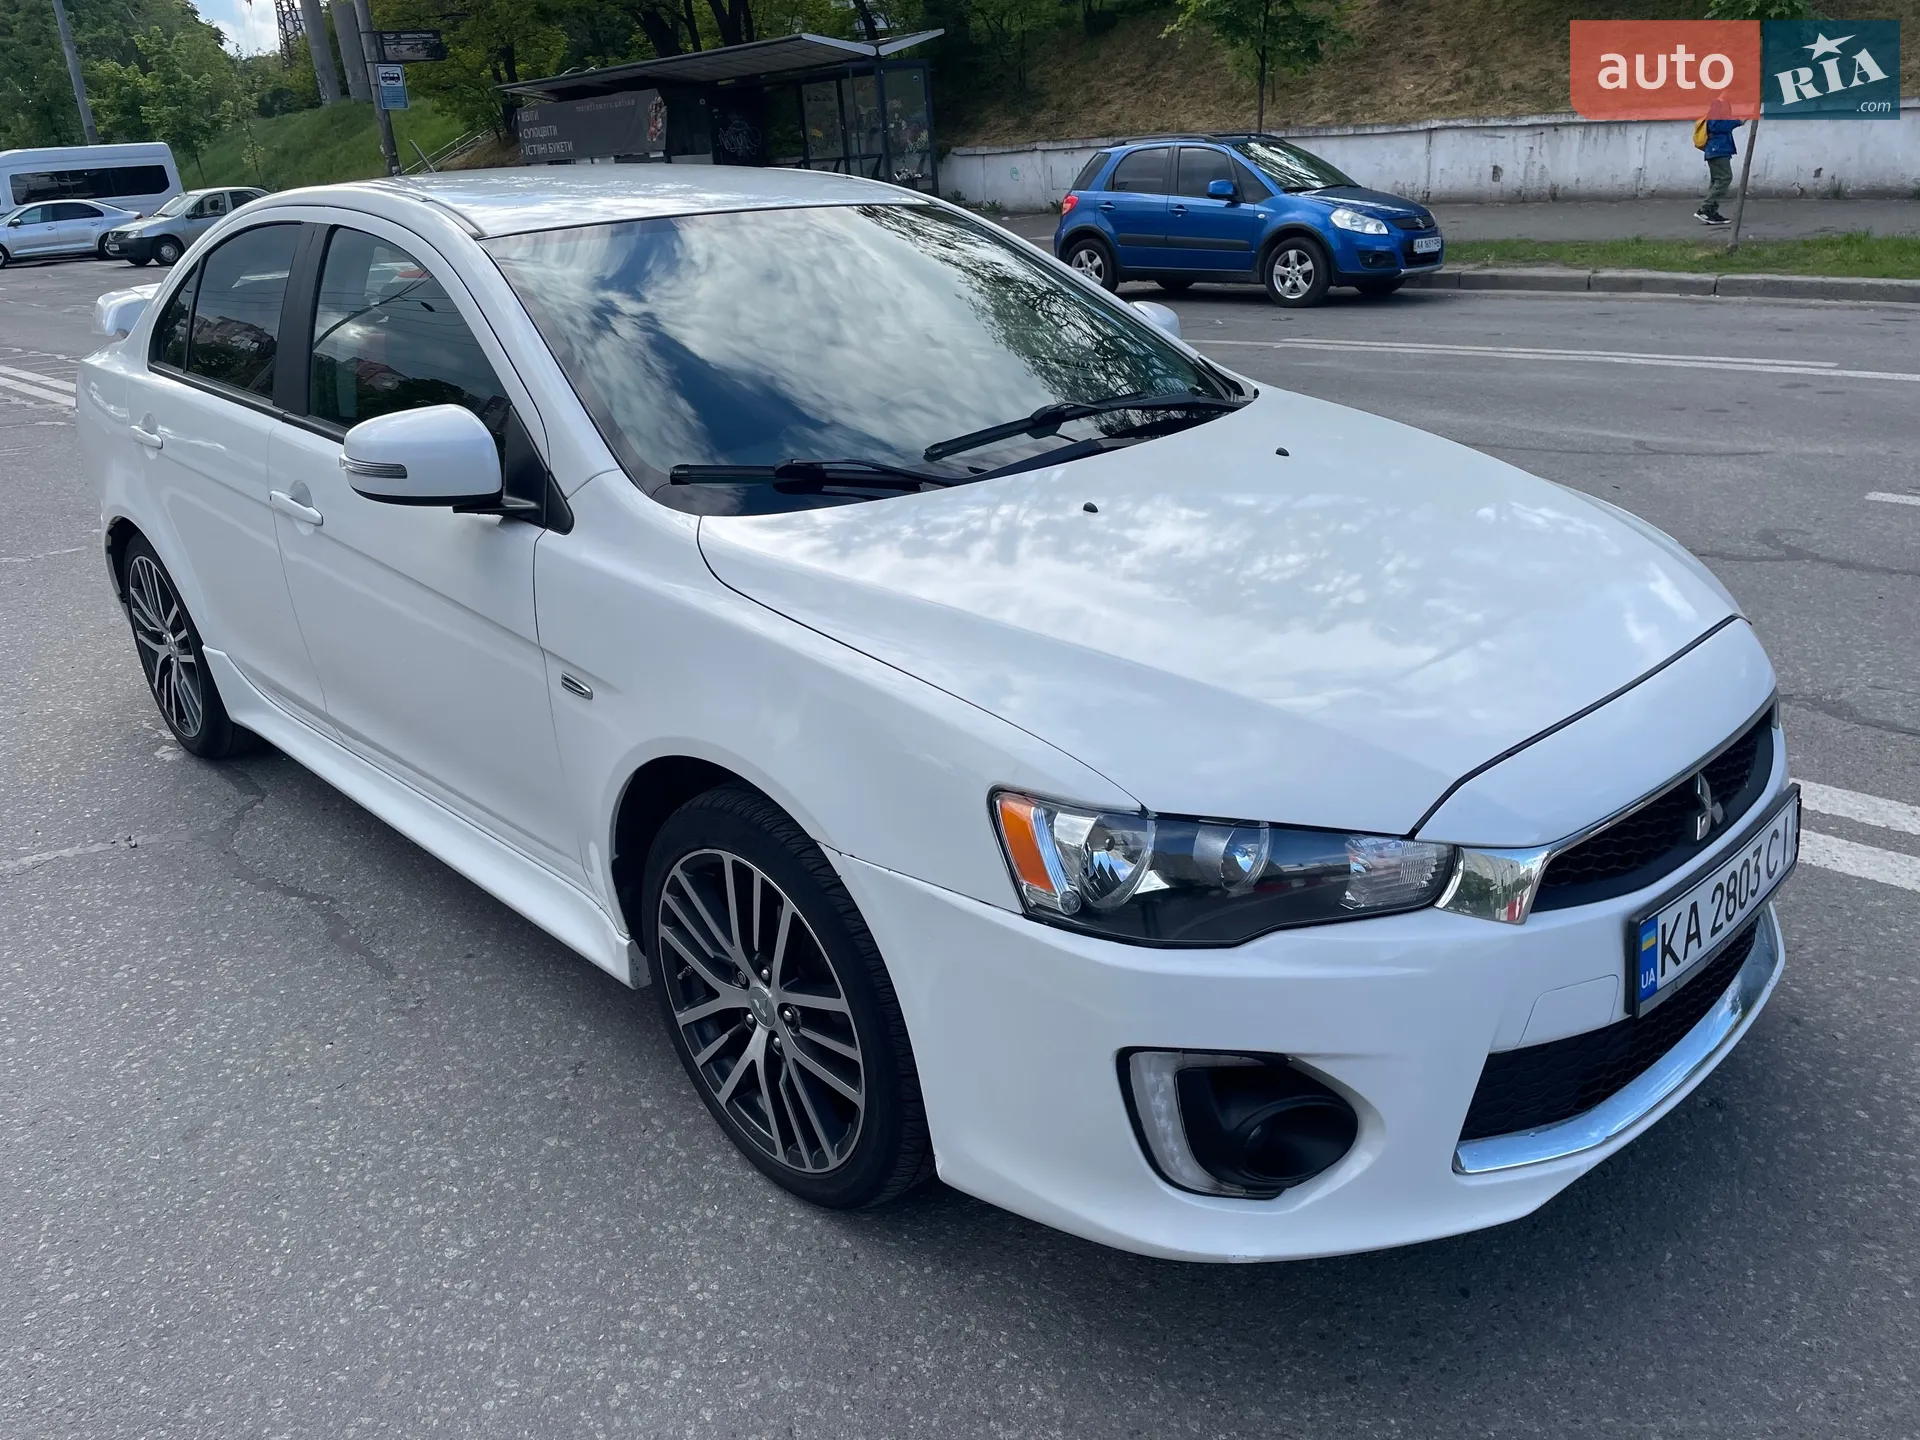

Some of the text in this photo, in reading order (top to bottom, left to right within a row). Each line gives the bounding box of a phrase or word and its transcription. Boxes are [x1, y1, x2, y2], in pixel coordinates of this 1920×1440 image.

[548, 141, 574, 154] БУКЕТИ
[1660, 900, 1702, 978] KA
[1710, 844, 1763, 939] 2803
[1641, 967, 1656, 989] UA
